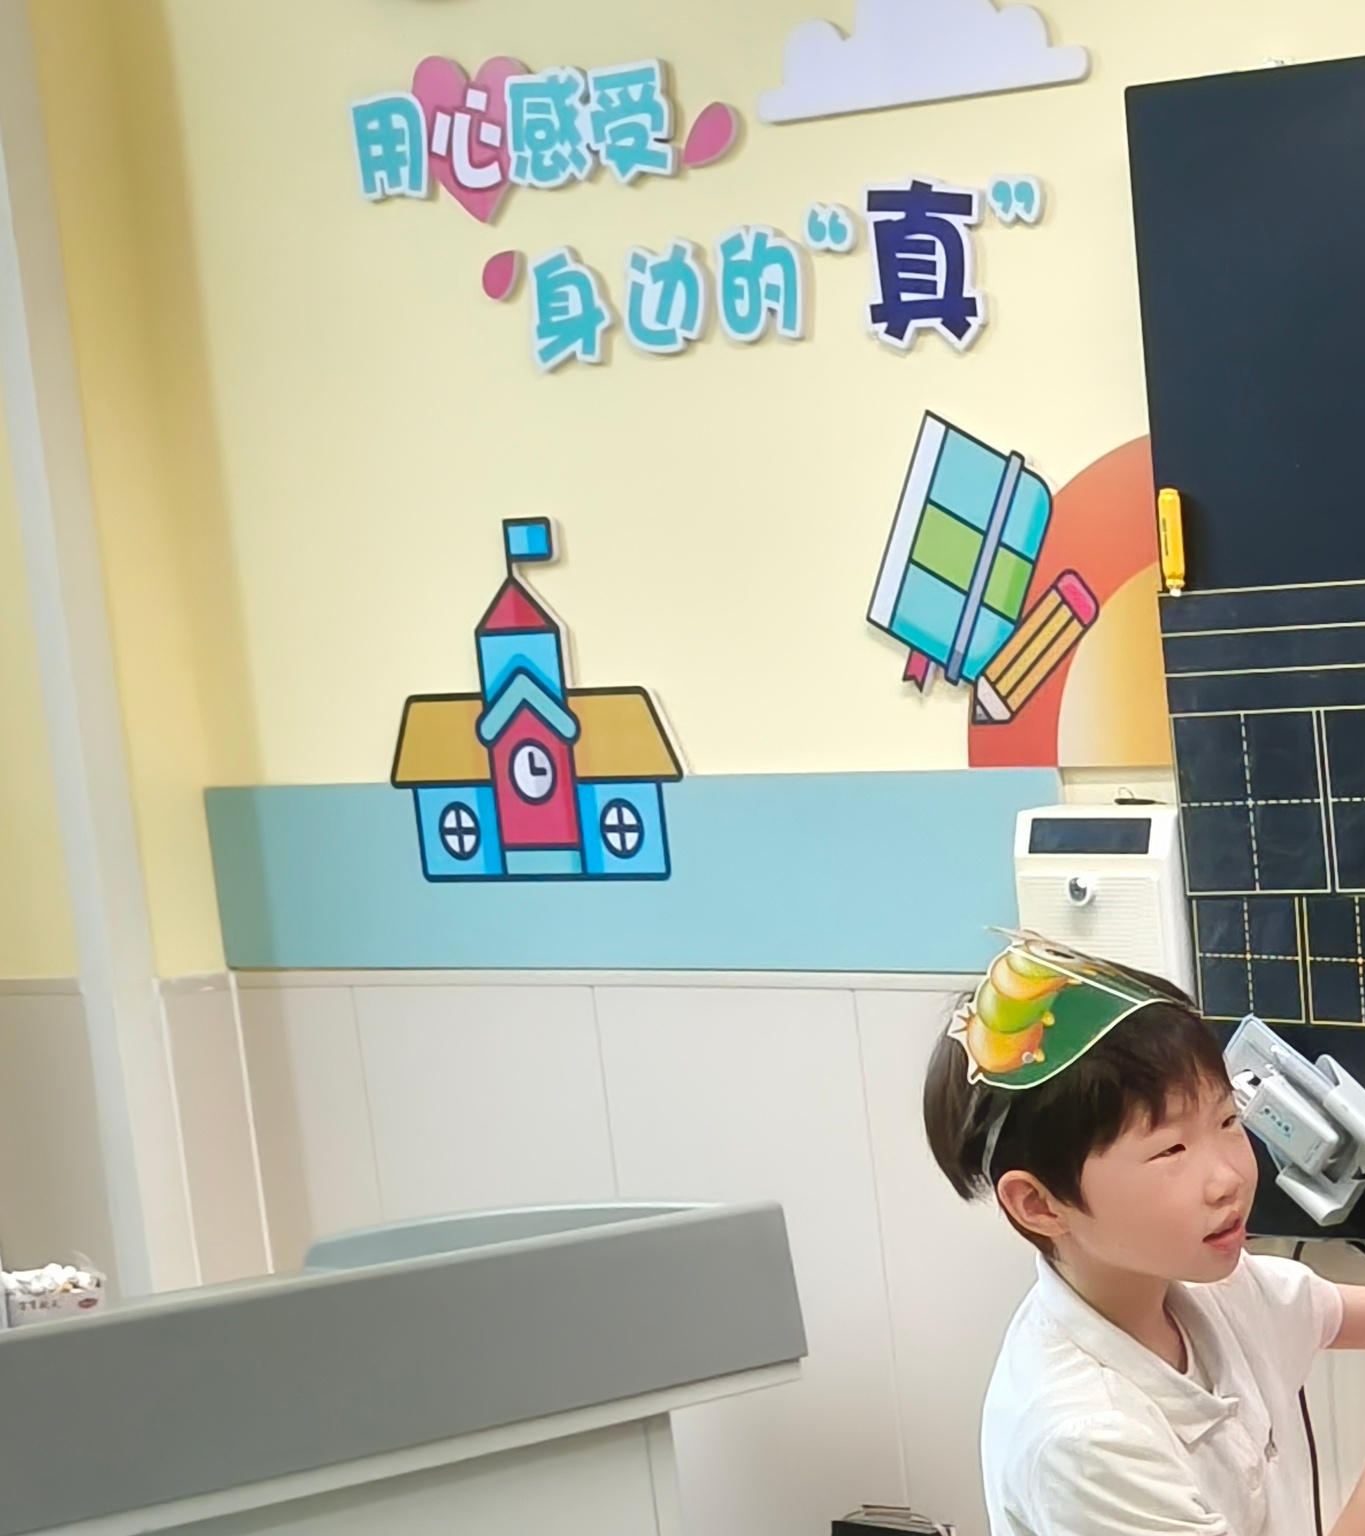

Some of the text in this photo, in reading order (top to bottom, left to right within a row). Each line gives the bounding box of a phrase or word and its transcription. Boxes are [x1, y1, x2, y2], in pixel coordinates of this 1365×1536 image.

[353, 62, 676, 197] 用心感受
[532, 179, 1040, 366] 身边的“真”
